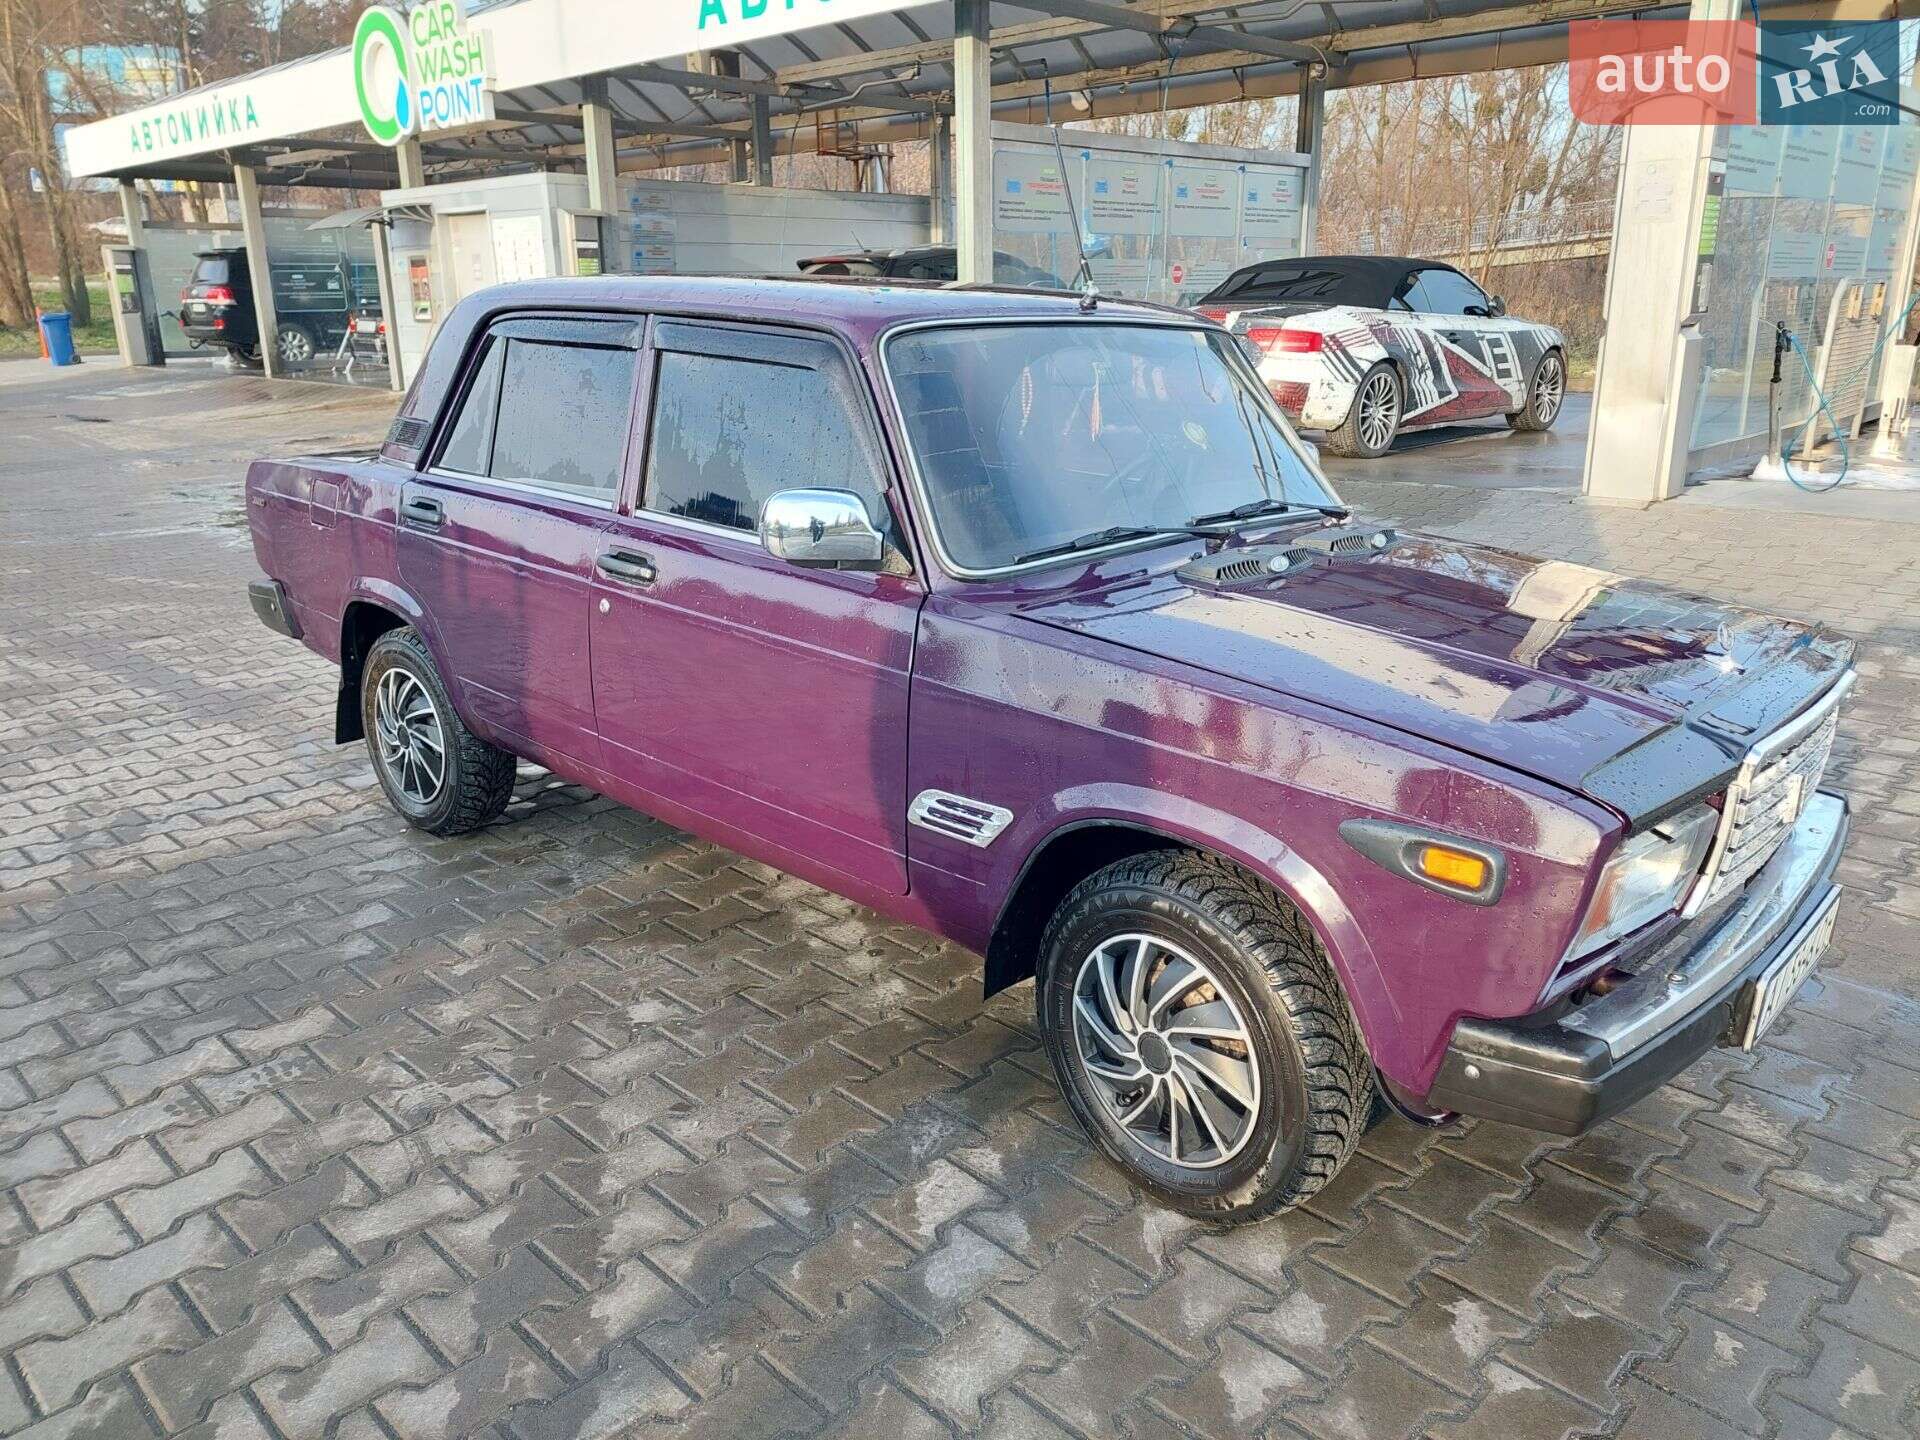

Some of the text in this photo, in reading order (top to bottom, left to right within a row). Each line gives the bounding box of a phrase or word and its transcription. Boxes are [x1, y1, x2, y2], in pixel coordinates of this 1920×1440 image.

[413, 3, 457, 47] CAR
[416, 36, 484, 85] WASH
[419, 77, 483, 126] POINT
